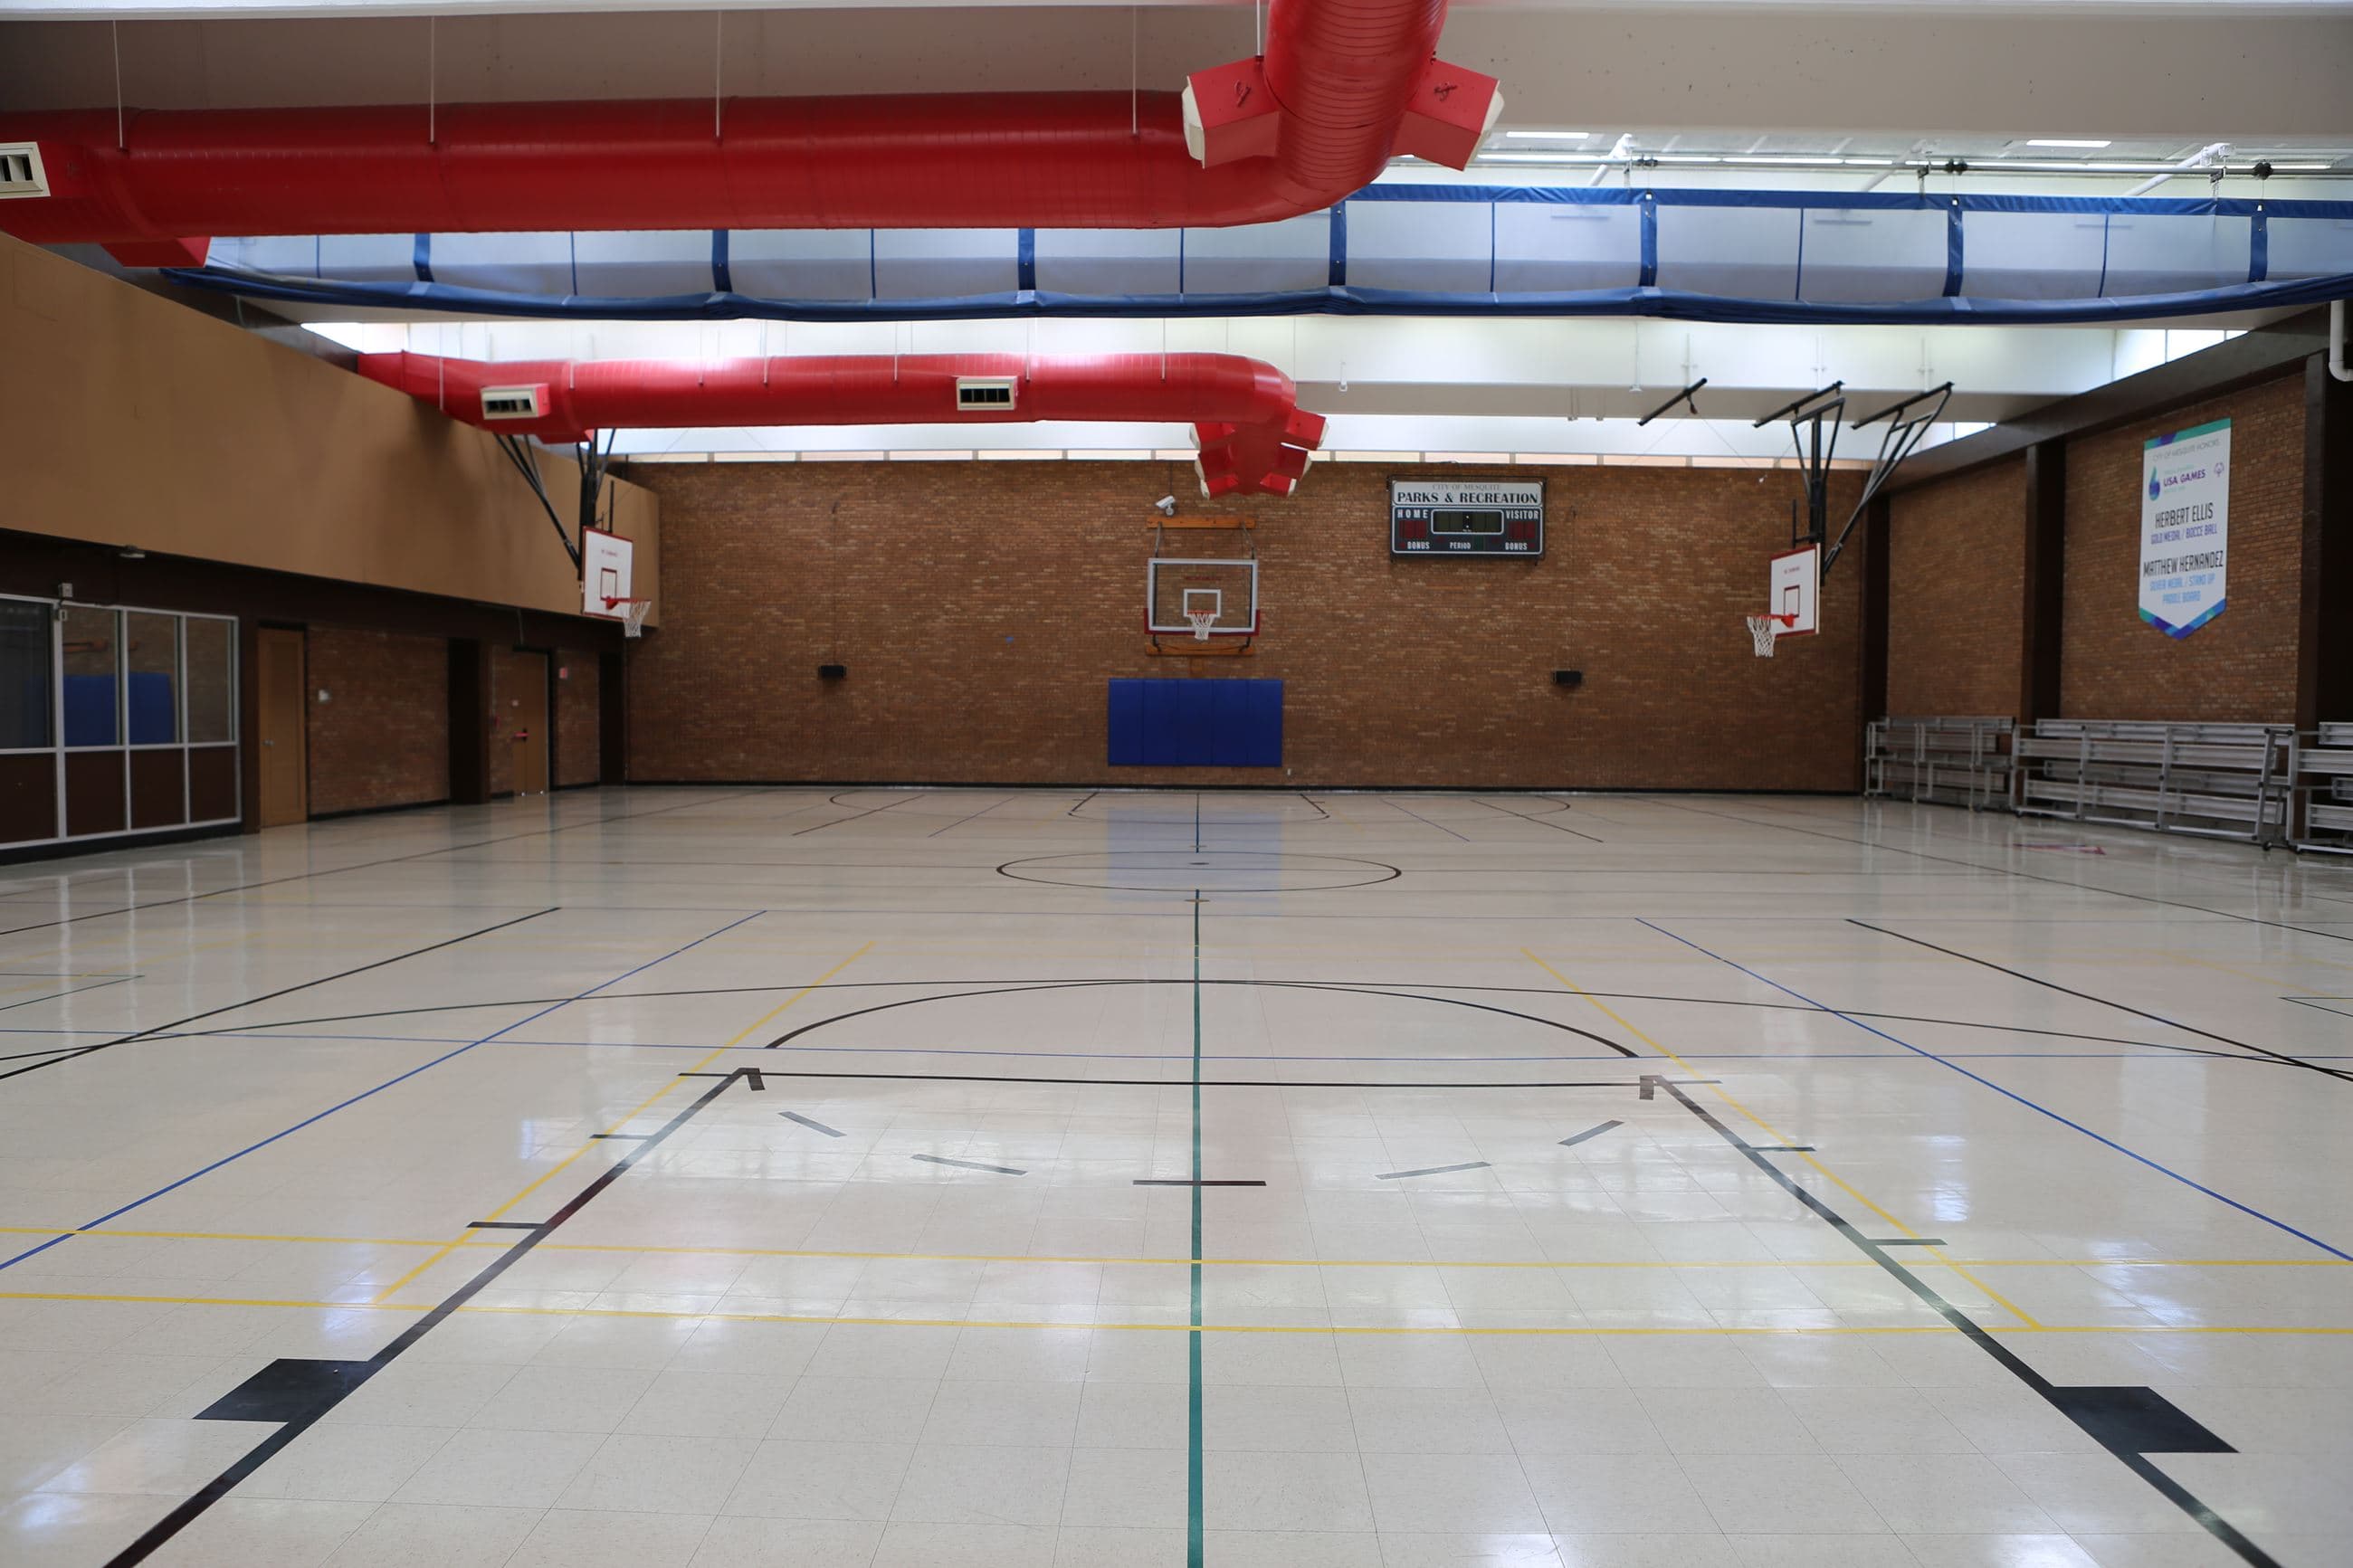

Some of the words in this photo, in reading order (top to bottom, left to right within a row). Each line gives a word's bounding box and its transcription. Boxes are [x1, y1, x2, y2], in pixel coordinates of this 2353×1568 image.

[2164, 476, 2178, 487] USA
[2180, 469, 2206, 483] GAMES
[1397, 492, 1439, 503] PARKS
[1444, 493, 1453, 503] &
[1460, 492, 1538, 504] RECREATION
[1397, 508, 1429, 518] HOME
[1506, 509, 1539, 519] VISITOR
[2155, 507, 2190, 528] HERBERT
[2192, 502, 2214, 522] ELLIS
[2186, 526, 2203, 538] BOCCE
[2205, 523, 2217, 536] BALL
[1406, 541, 1430, 550] BONUS
[1449, 542, 1472, 550] PERIOD
[1505, 542, 1528, 550] BONUS
[2143, 557, 2177, 577] MATTHEW
[2179, 550, 2224, 573] HERNANDEZ
